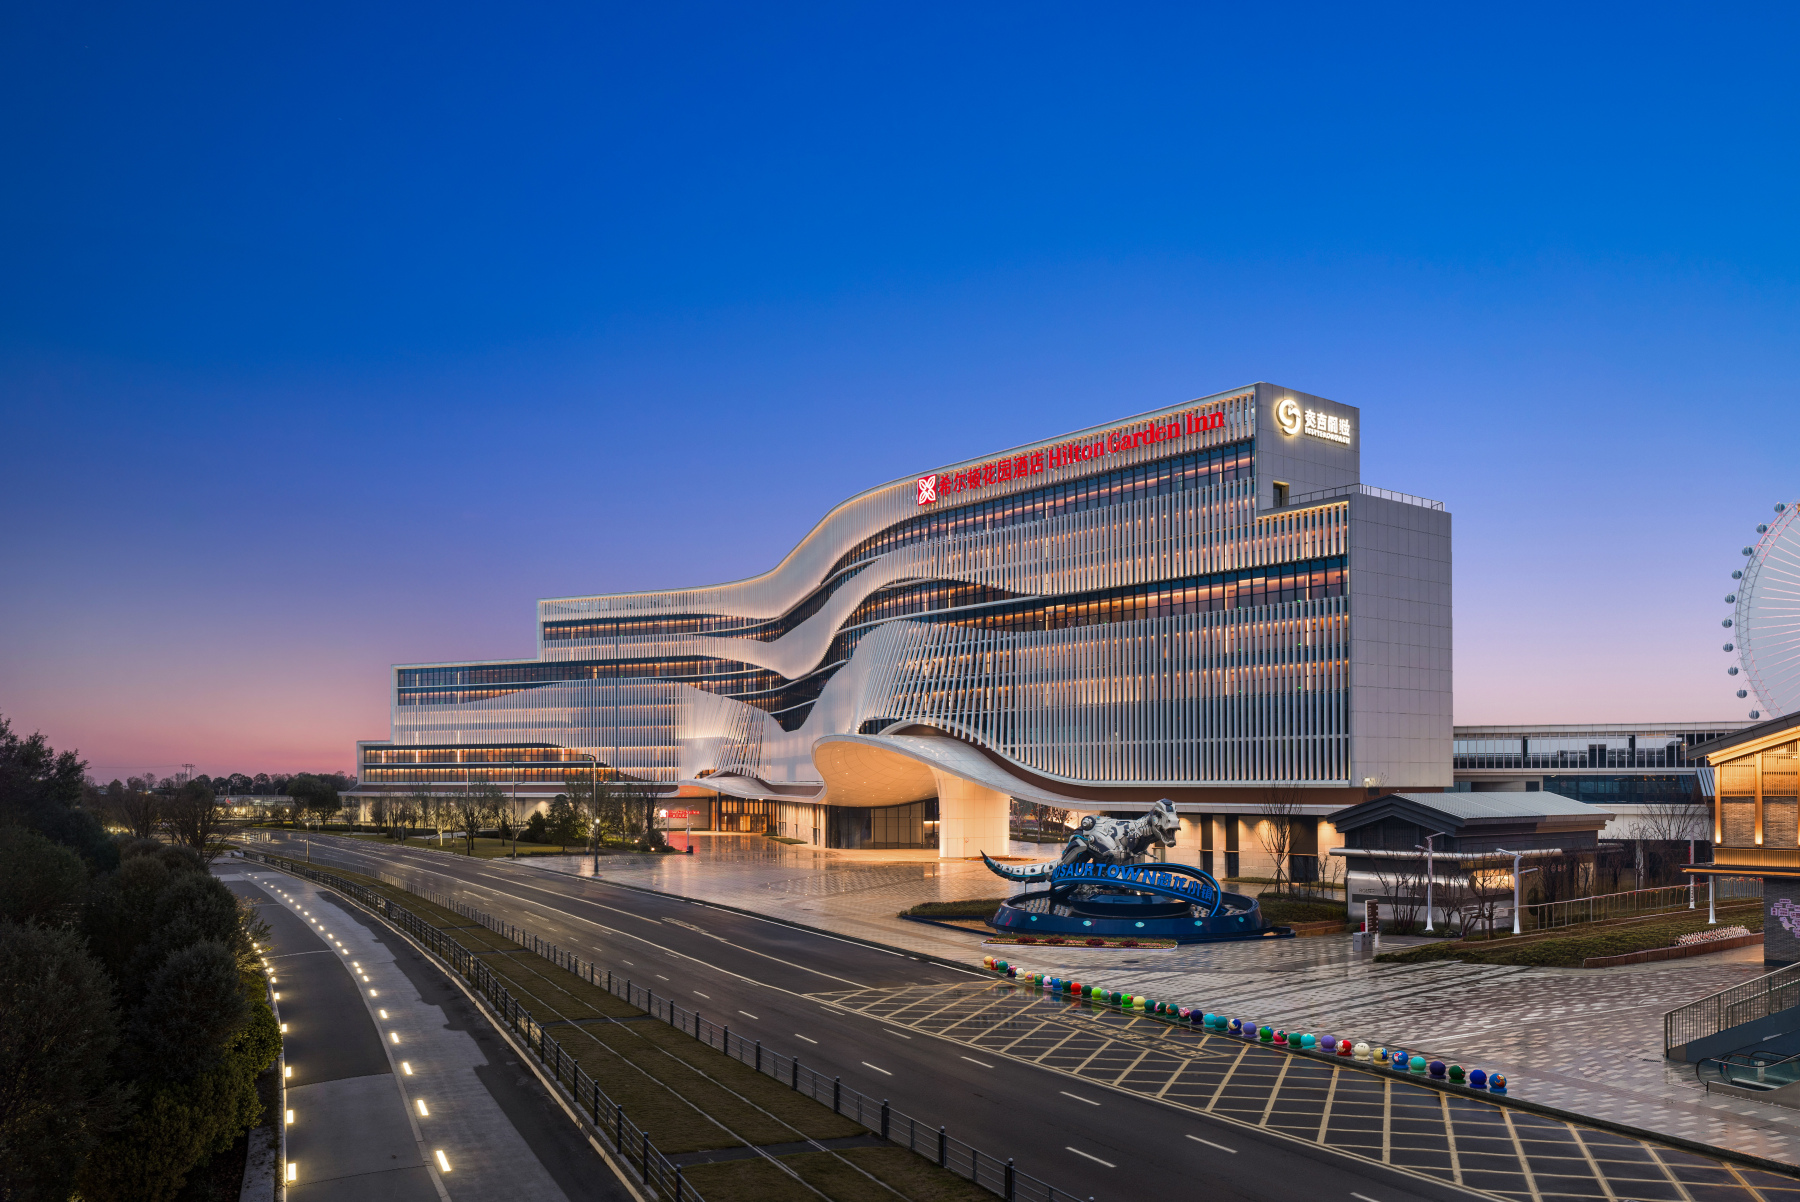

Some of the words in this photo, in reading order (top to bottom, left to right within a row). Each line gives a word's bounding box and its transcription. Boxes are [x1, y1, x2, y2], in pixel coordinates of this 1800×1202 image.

[1049, 440, 1105, 469] Hilton
[1107, 421, 1181, 454] Garden
[1186, 411, 1225, 435] Inn
[938, 452, 1044, 497] 希尔顿花园酒店
[1157, 872, 1214, 902] 恐龙小镇
